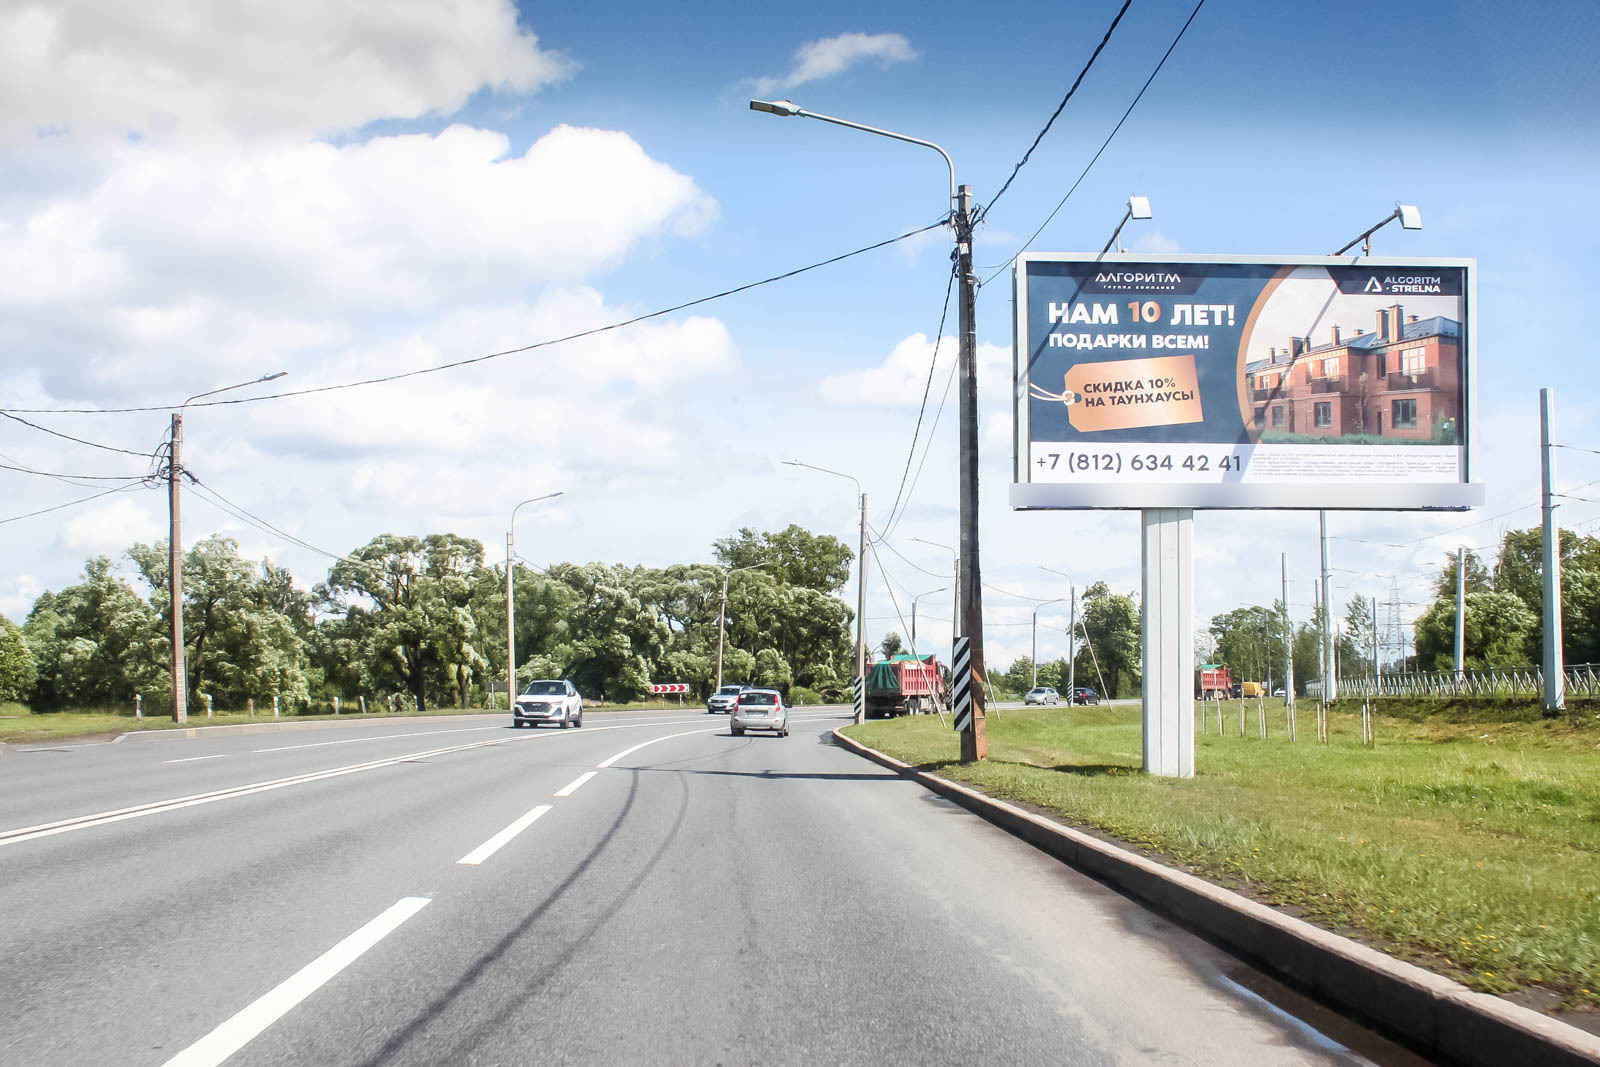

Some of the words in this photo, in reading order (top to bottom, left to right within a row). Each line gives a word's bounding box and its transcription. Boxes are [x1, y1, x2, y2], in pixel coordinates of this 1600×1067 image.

[1095, 272, 1181, 283] АЛГОРИТМ
[1384, 276, 1441, 284] ALGORITM
[1391, 285, 1441, 293] STRELNA
[1049, 302, 1118, 325] НАМ
[1128, 301, 1161, 323] 10
[1171, 304, 1235, 326] ЛЕТ!
[1049, 334, 1146, 350] ПОДАРКИ
[1152, 335, 1209, 349] ВСЕМ!
[1084, 379, 1144, 394] СКИДКА
[1148, 377, 1175, 390] 10%
[1085, 395, 1105, 408] НА
[1109, 390, 1194, 406] ТАУНХАУСЫ
[1036, 454, 1060, 470] +7
[1069, 452, 1122, 473] (812)
[1131, 454, 1173, 471] 634
[1182, 455, 1209, 471] 42
[1218, 455, 1241, 472] 41
